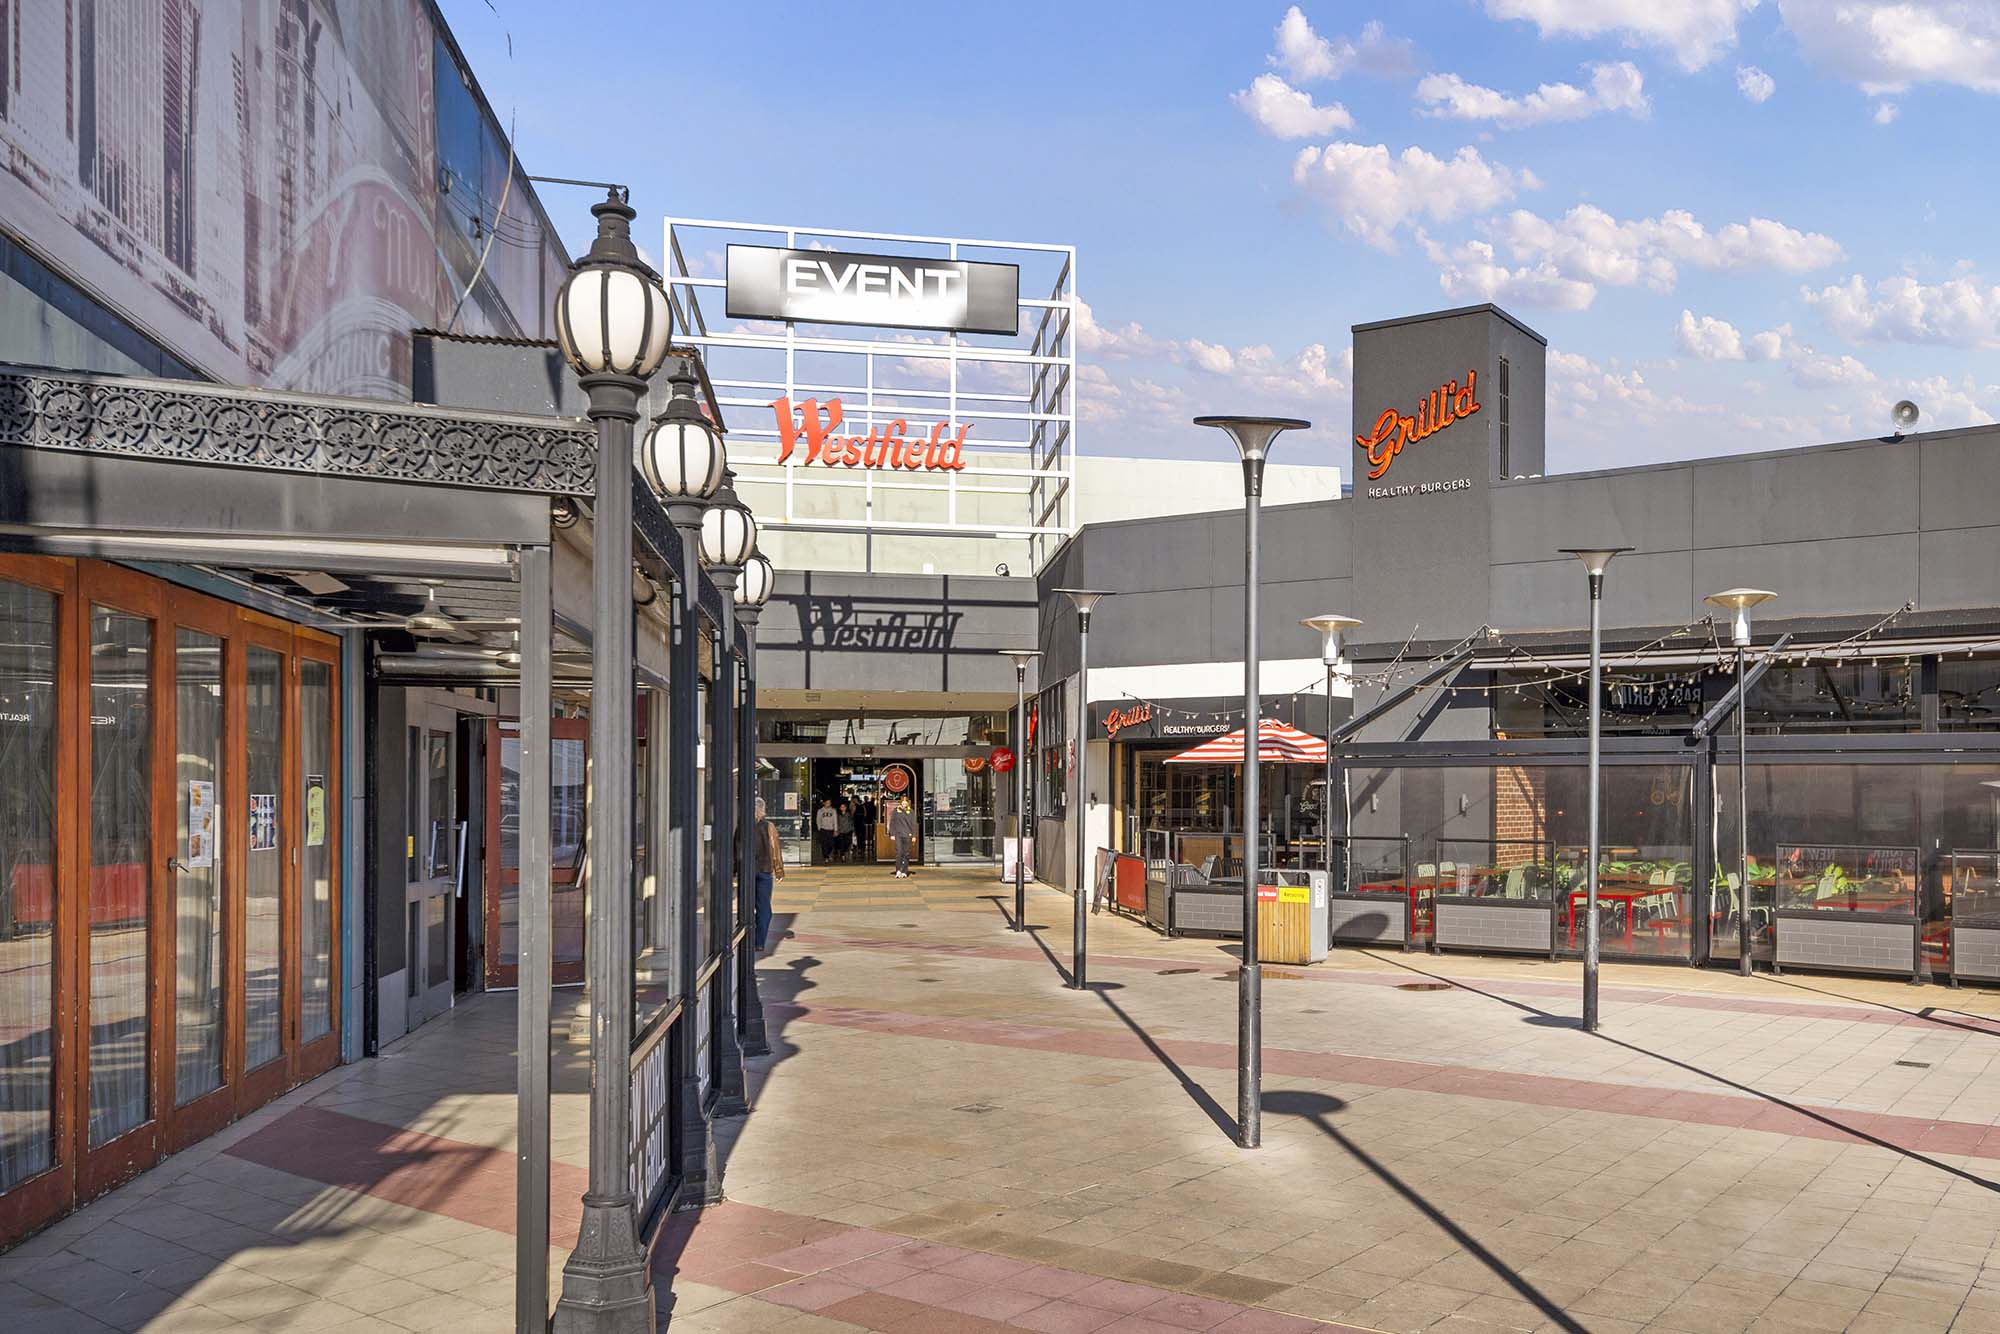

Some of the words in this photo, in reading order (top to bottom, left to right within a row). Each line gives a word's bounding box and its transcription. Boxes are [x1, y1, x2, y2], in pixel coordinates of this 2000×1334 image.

[787, 259, 961, 301] EVENT
[768, 397, 974, 471] Westfield
[1356, 369, 1481, 480] Grill'd
[1368, 484, 1416, 499] HEALTHY
[1420, 478, 1471, 495] BURGERS
[1163, 724, 1194, 735] HEALTHY
[643, 1037, 666, 1131] YORK
[645, 1115, 666, 1199] GRILL
